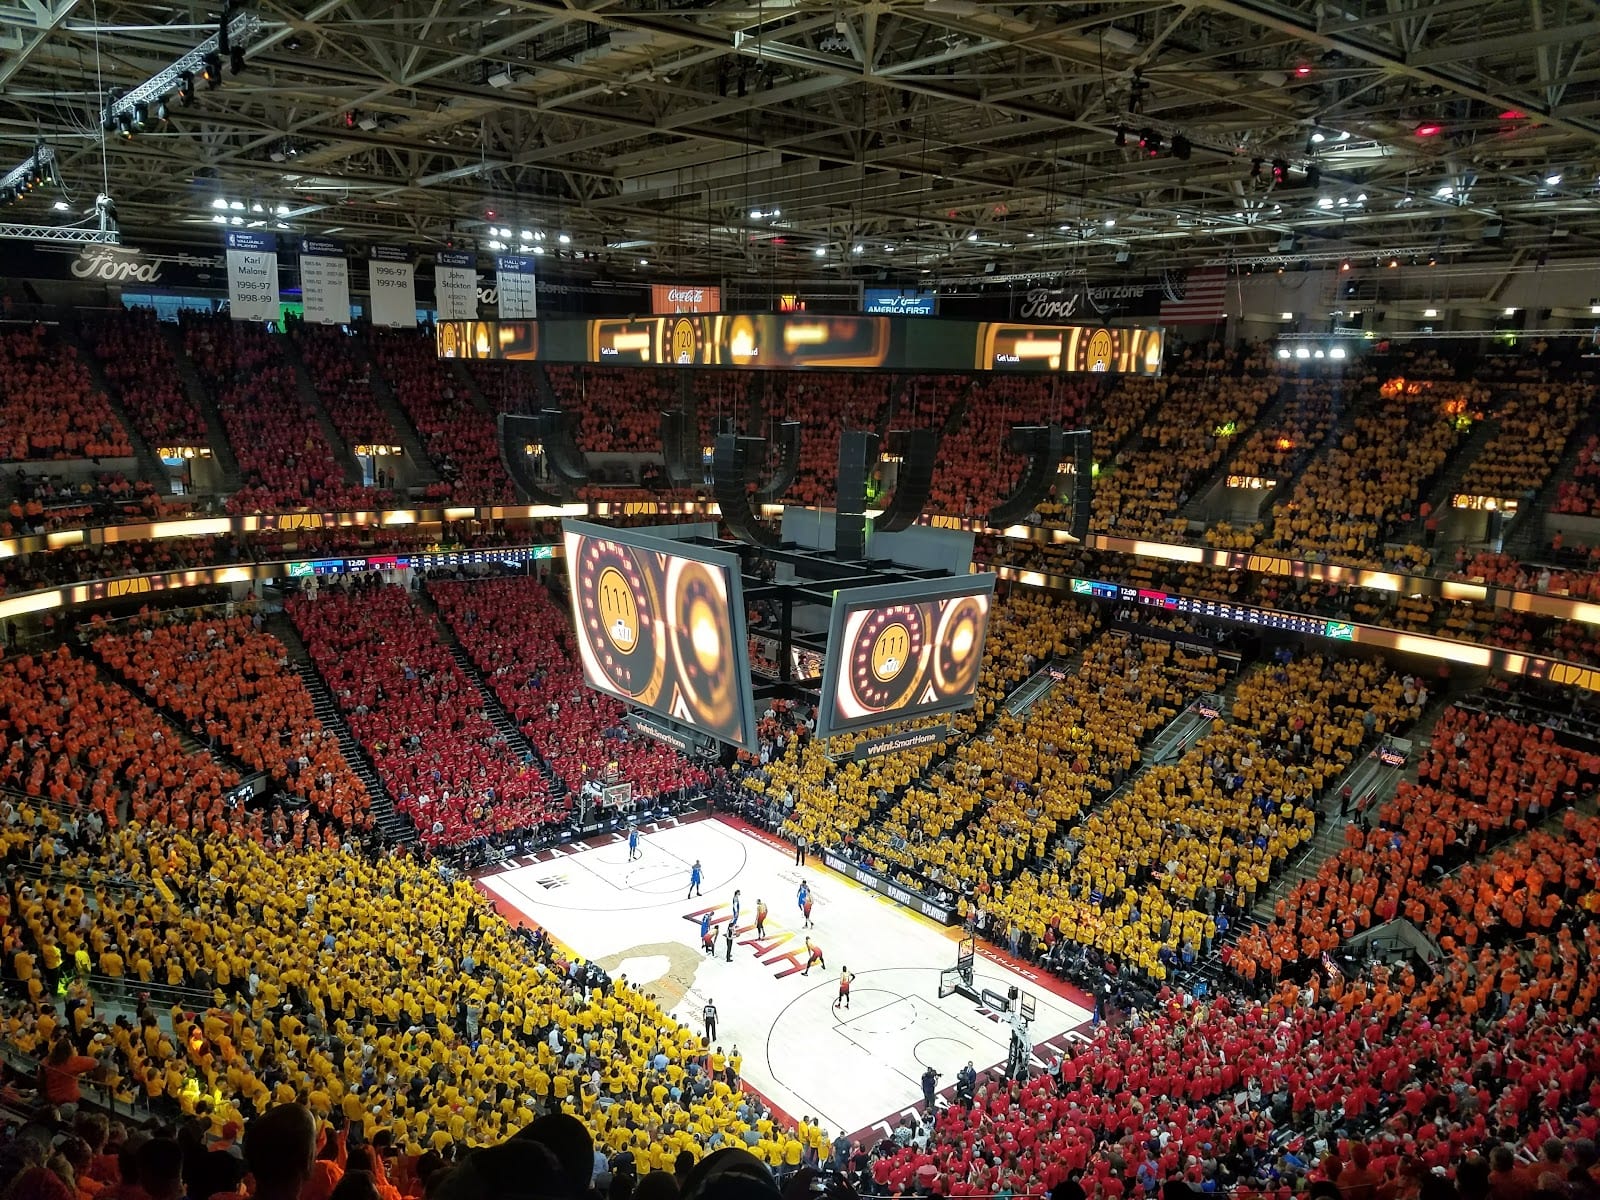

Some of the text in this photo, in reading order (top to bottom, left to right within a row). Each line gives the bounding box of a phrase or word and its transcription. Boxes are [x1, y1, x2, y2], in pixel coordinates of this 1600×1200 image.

[71, 244, 162, 282] Ford
[245, 256, 260, 264] Karl
[238, 266, 267, 275] Malone
[376, 267, 406, 276] 1996-97
[237, 281, 270, 289] 1996-97
[377, 280, 407, 288] 1997-98
[442, 281, 471, 289] Stockton
[237, 294, 272, 302] 1998-99
[1088, 286, 1144, 300] Fan Zone
[1020, 288, 1079, 318] Ford
[676, 331, 692, 348] 120
[1093, 341, 1109, 357] 120
[996, 354, 1020, 362] Get Loud
[1121, 588, 1137, 596] 12:00
[604, 584, 630, 617] 111
[1331, 627, 1351, 639] Sprite
[882, 636, 903, 656] 111
[868, 734, 936, 755] vivint.SmartHome
[500, 842, 593, 870] UTAH
[611, 818, 686, 842] JZZ
[891, 886, 910, 905] PLAYOFFS
[926, 903, 948, 923] PLAYOFFS
[975, 945, 1039, 980] UTAHJAZZ
